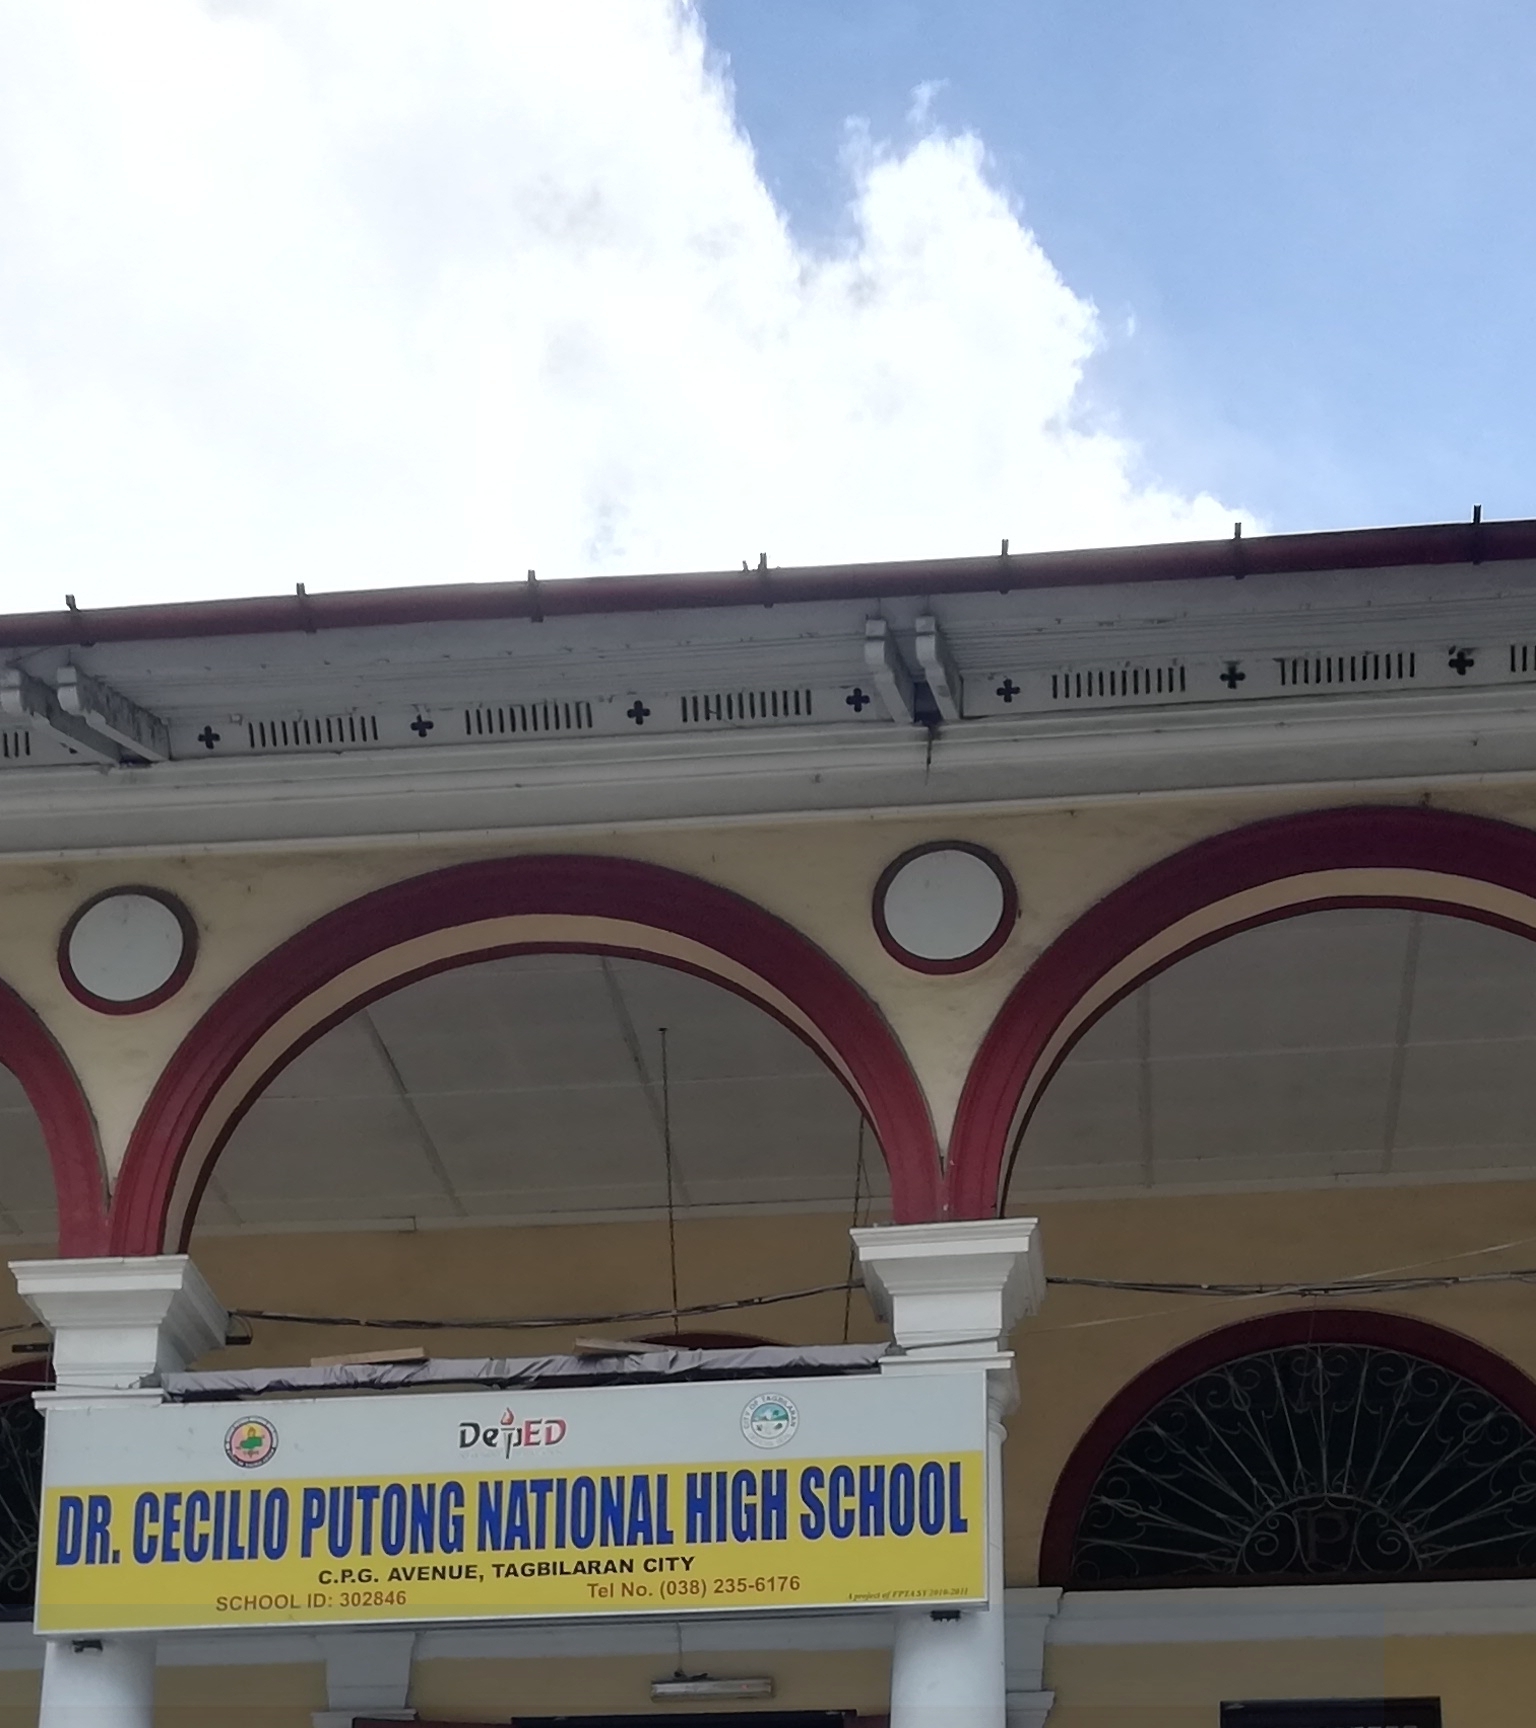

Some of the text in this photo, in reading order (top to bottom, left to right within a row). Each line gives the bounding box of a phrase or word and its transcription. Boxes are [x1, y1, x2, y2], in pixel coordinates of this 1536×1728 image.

[55, 1460, 969, 1566] DR. CECILIO PUTONG NATIONAL HIGH SCHOOL
[317, 1555, 696, 1586] C.P.G. AVENUE, TAGBILARAN CITY
[215, 1589, 407, 1613] SCHOOL ID: 302846
[587, 1575, 801, 1600] Tel No. (038) 235-6176
